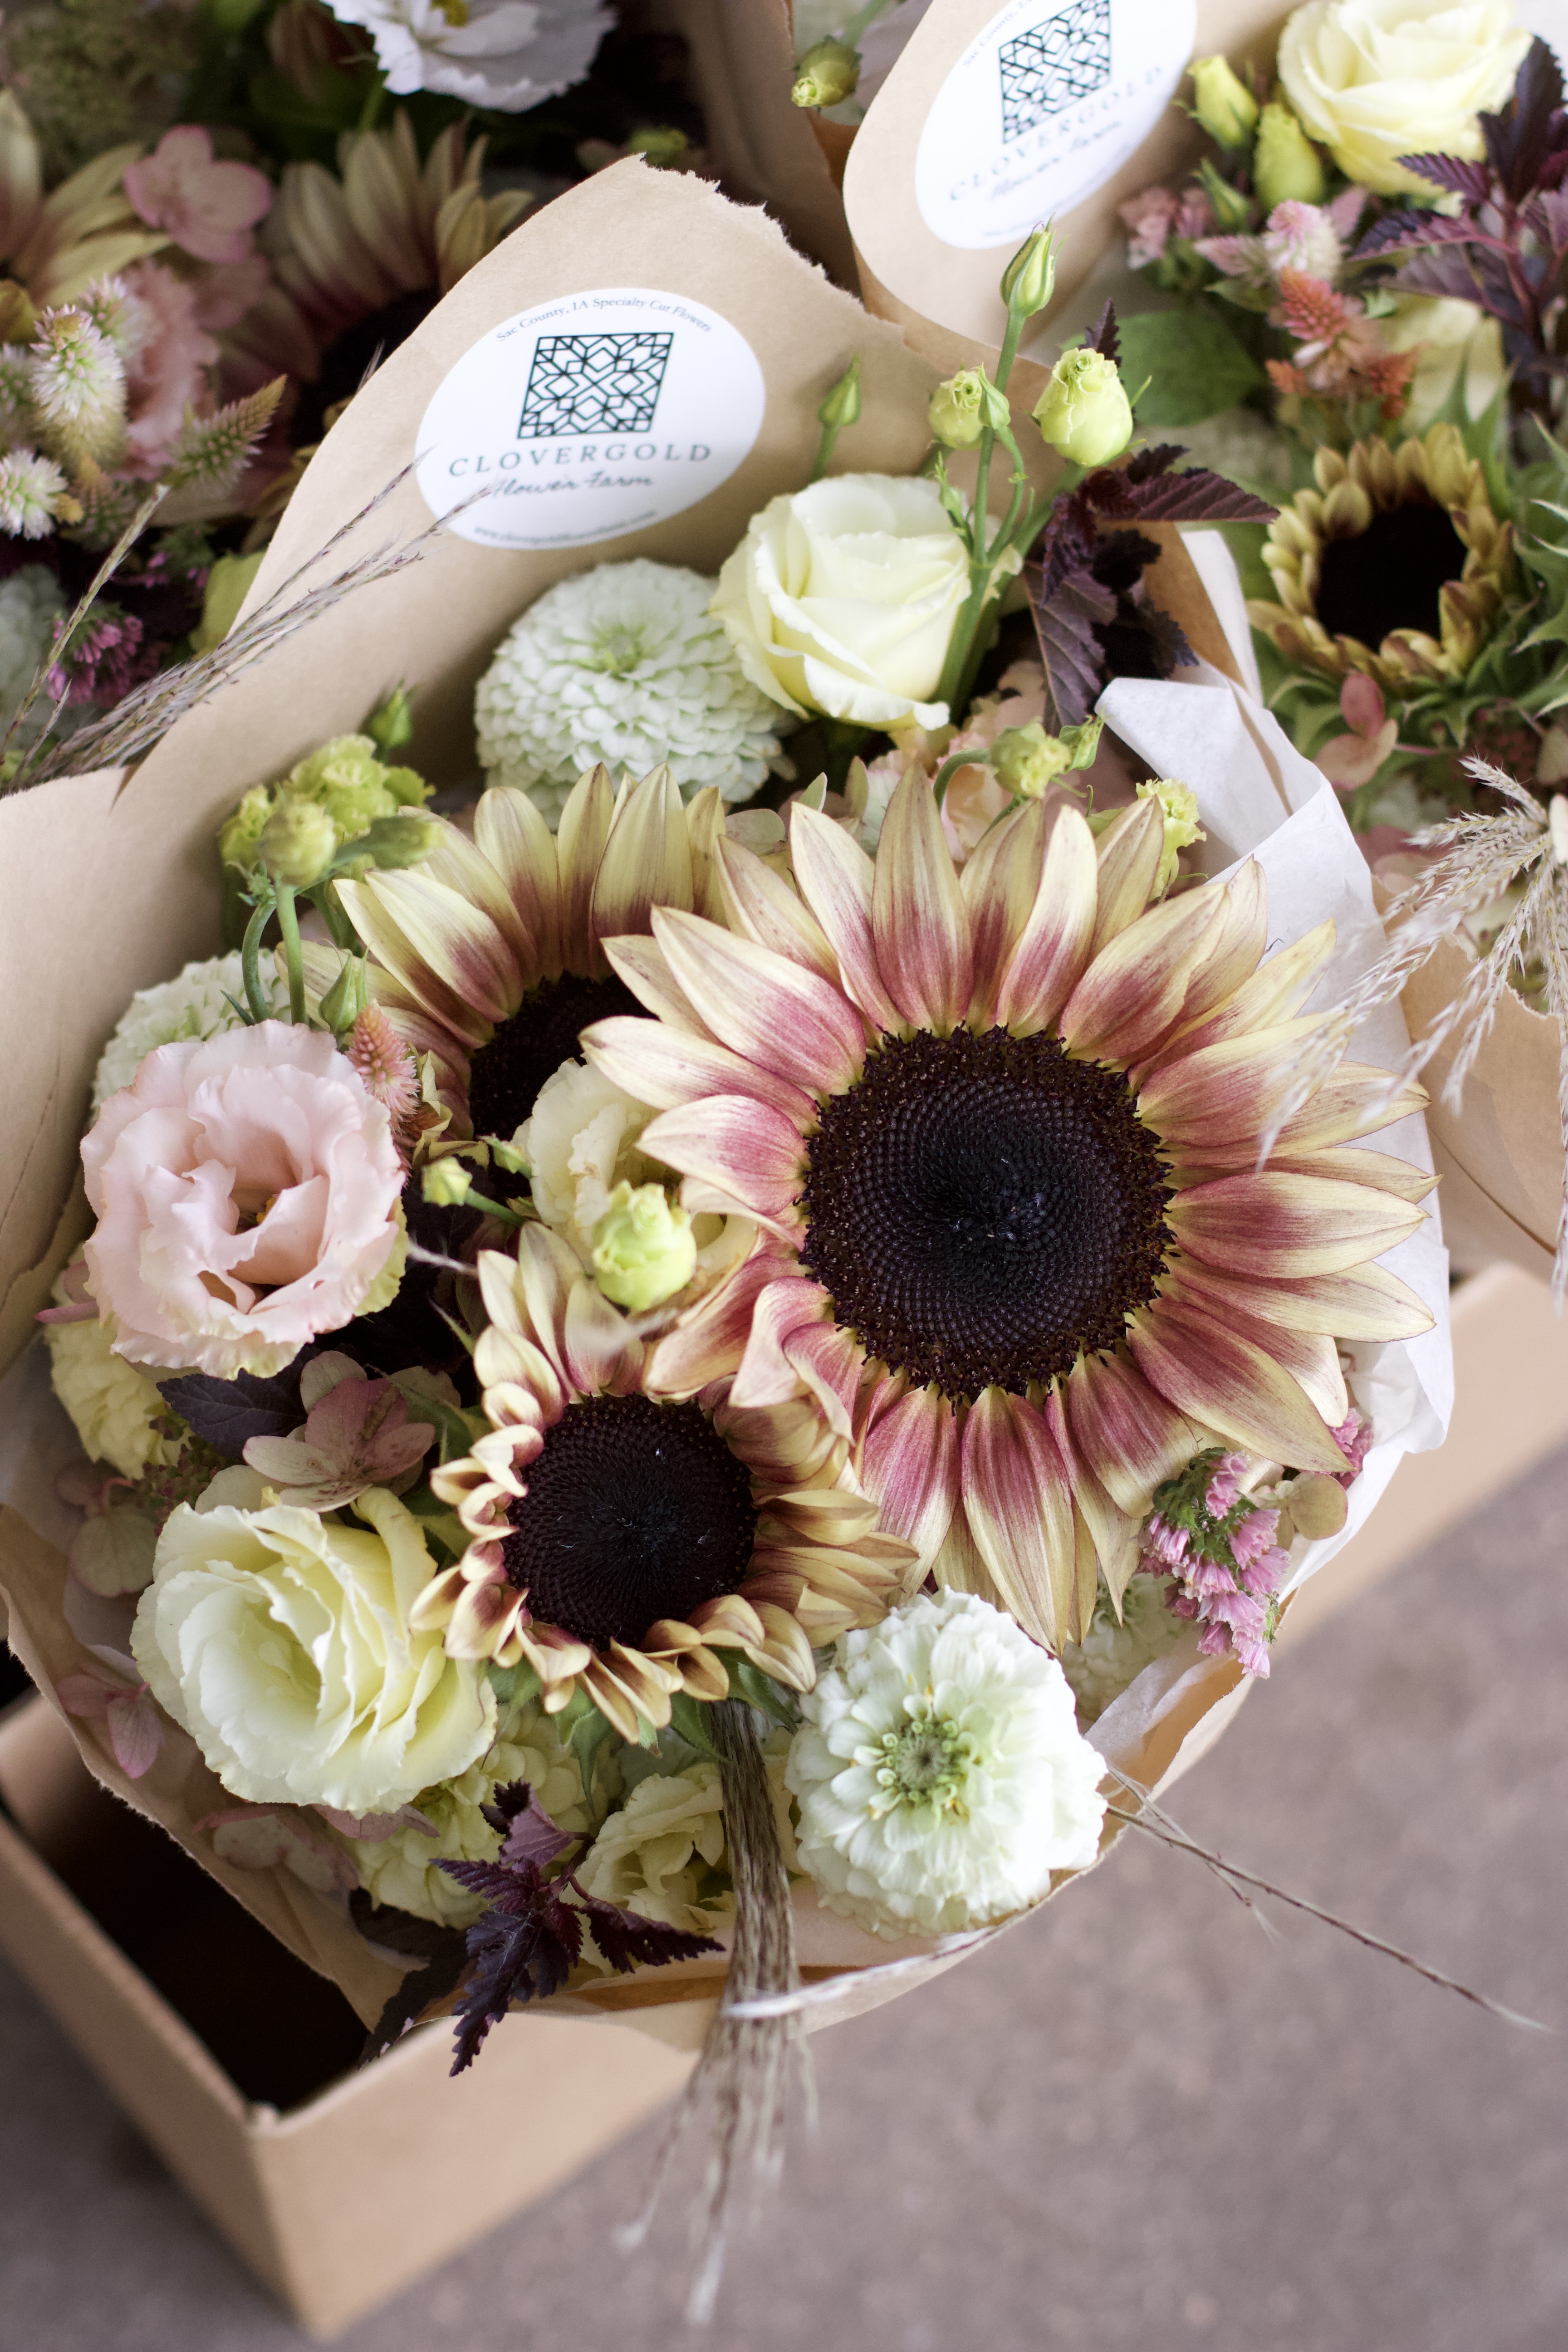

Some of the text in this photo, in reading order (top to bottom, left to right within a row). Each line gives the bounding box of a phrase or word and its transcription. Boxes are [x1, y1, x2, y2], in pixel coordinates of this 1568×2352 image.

[950, 66, 1162, 201] CLOVERGOLD
[497, 327, 518, 341] Sac
[573, 300, 588, 311] IA
[593, 297, 647, 310] Specialty
[649, 299, 671, 312] Cut
[671, 305, 712, 332] Flowers
[449, 444, 711, 476] CLOVERGOLD
